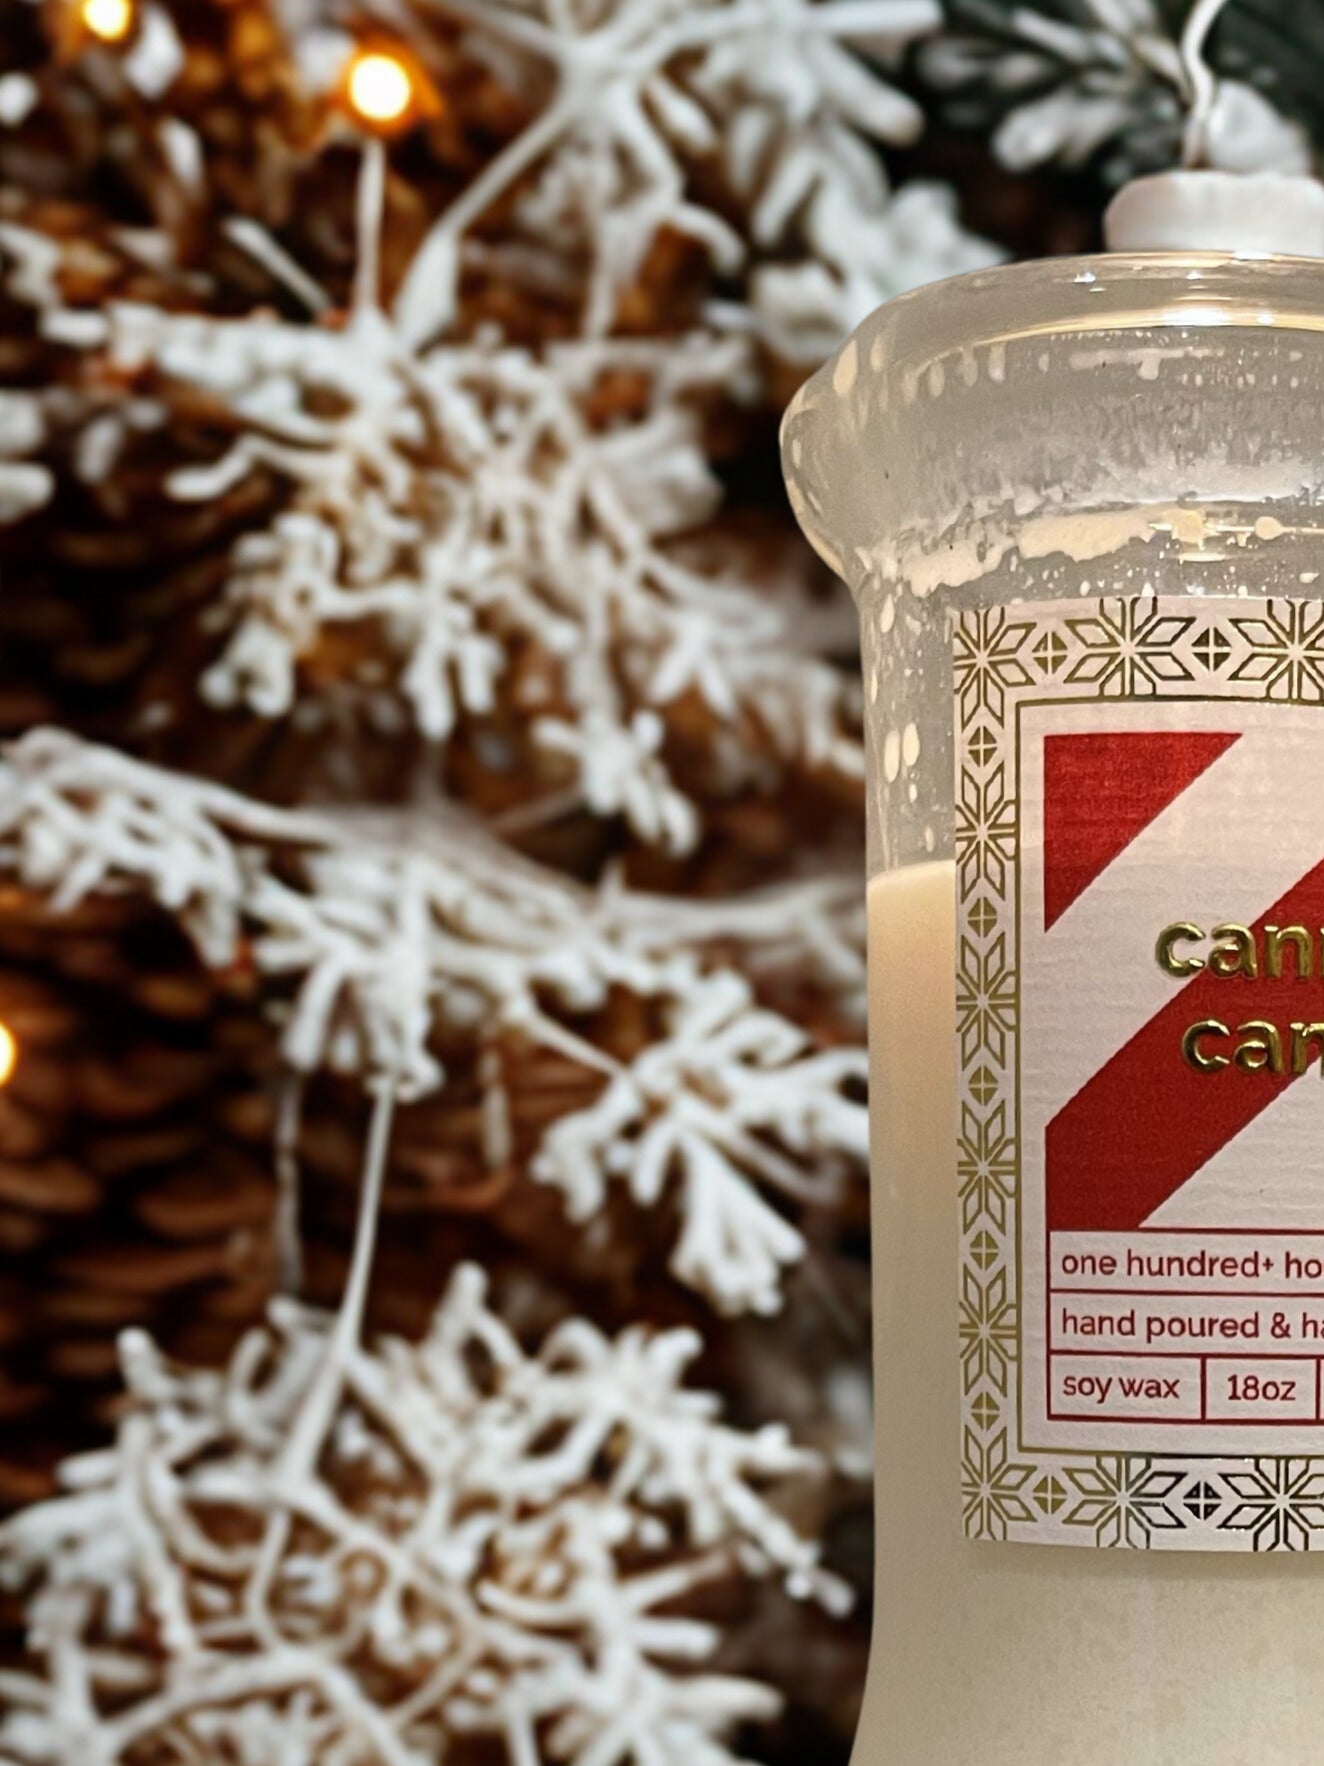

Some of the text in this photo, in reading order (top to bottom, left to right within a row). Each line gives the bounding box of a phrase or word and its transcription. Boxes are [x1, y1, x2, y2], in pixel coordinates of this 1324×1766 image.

[1061, 1253, 1117, 1276] one
[1127, 1249, 1275, 1279] hundred+
[1062, 1309, 1136, 1337] hand
[1146, 1312, 1260, 1343] poured
[1270, 1313, 1291, 1339] &
[1062, 1375, 1180, 1404] soy wax
[1226, 1375, 1297, 1401] 18oz
